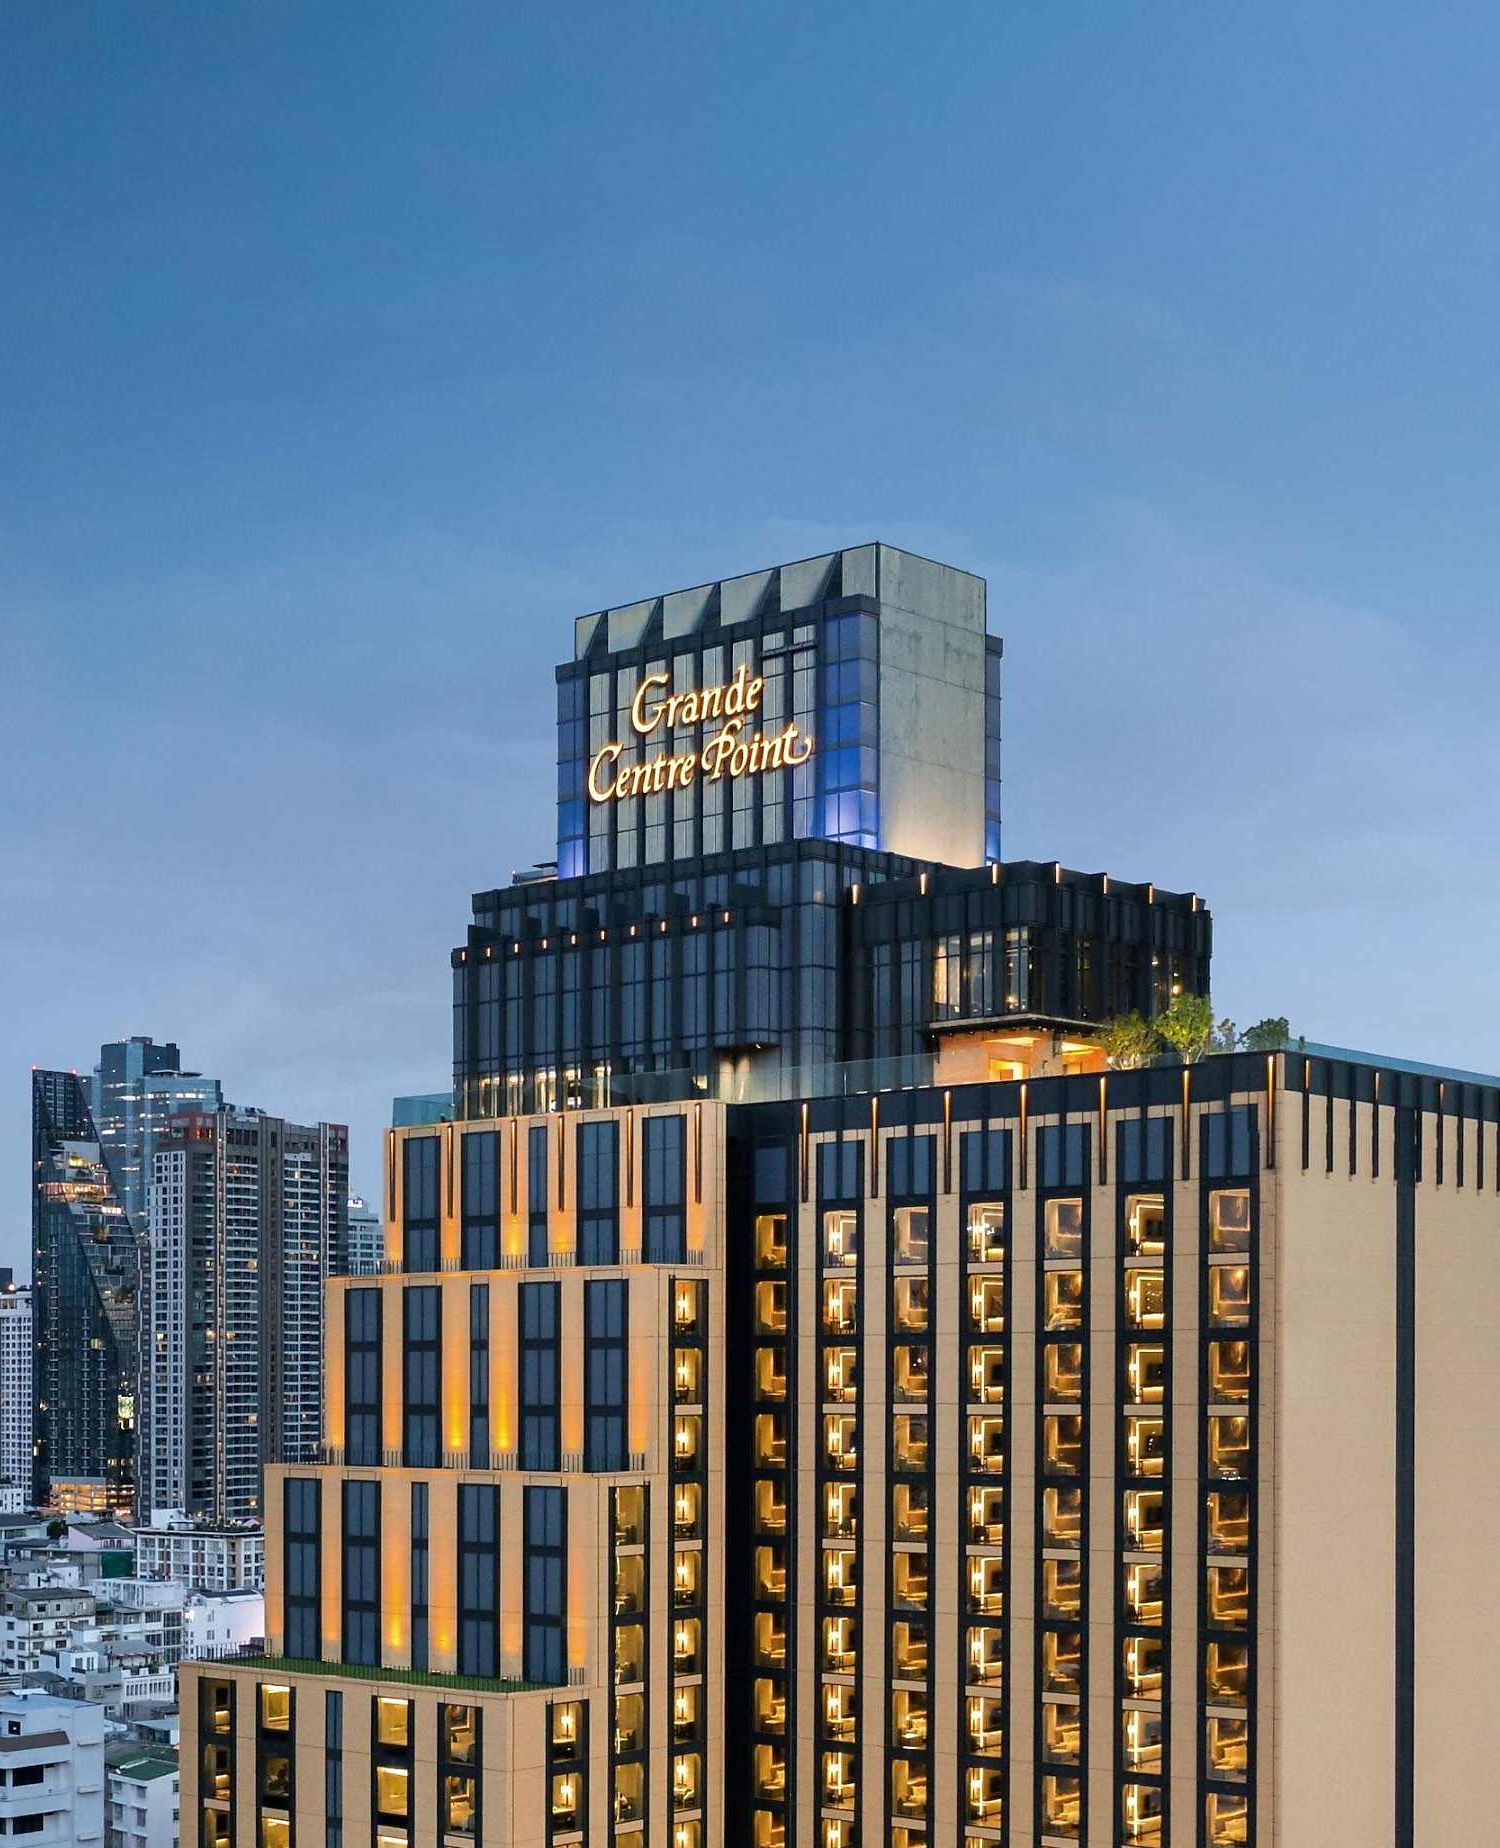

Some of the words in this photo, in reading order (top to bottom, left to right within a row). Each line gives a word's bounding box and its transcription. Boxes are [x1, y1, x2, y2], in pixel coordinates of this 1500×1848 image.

[631, 663, 764, 733] Grande
[587, 743, 696, 802] Centre
[701, 719, 813, 780] Point
